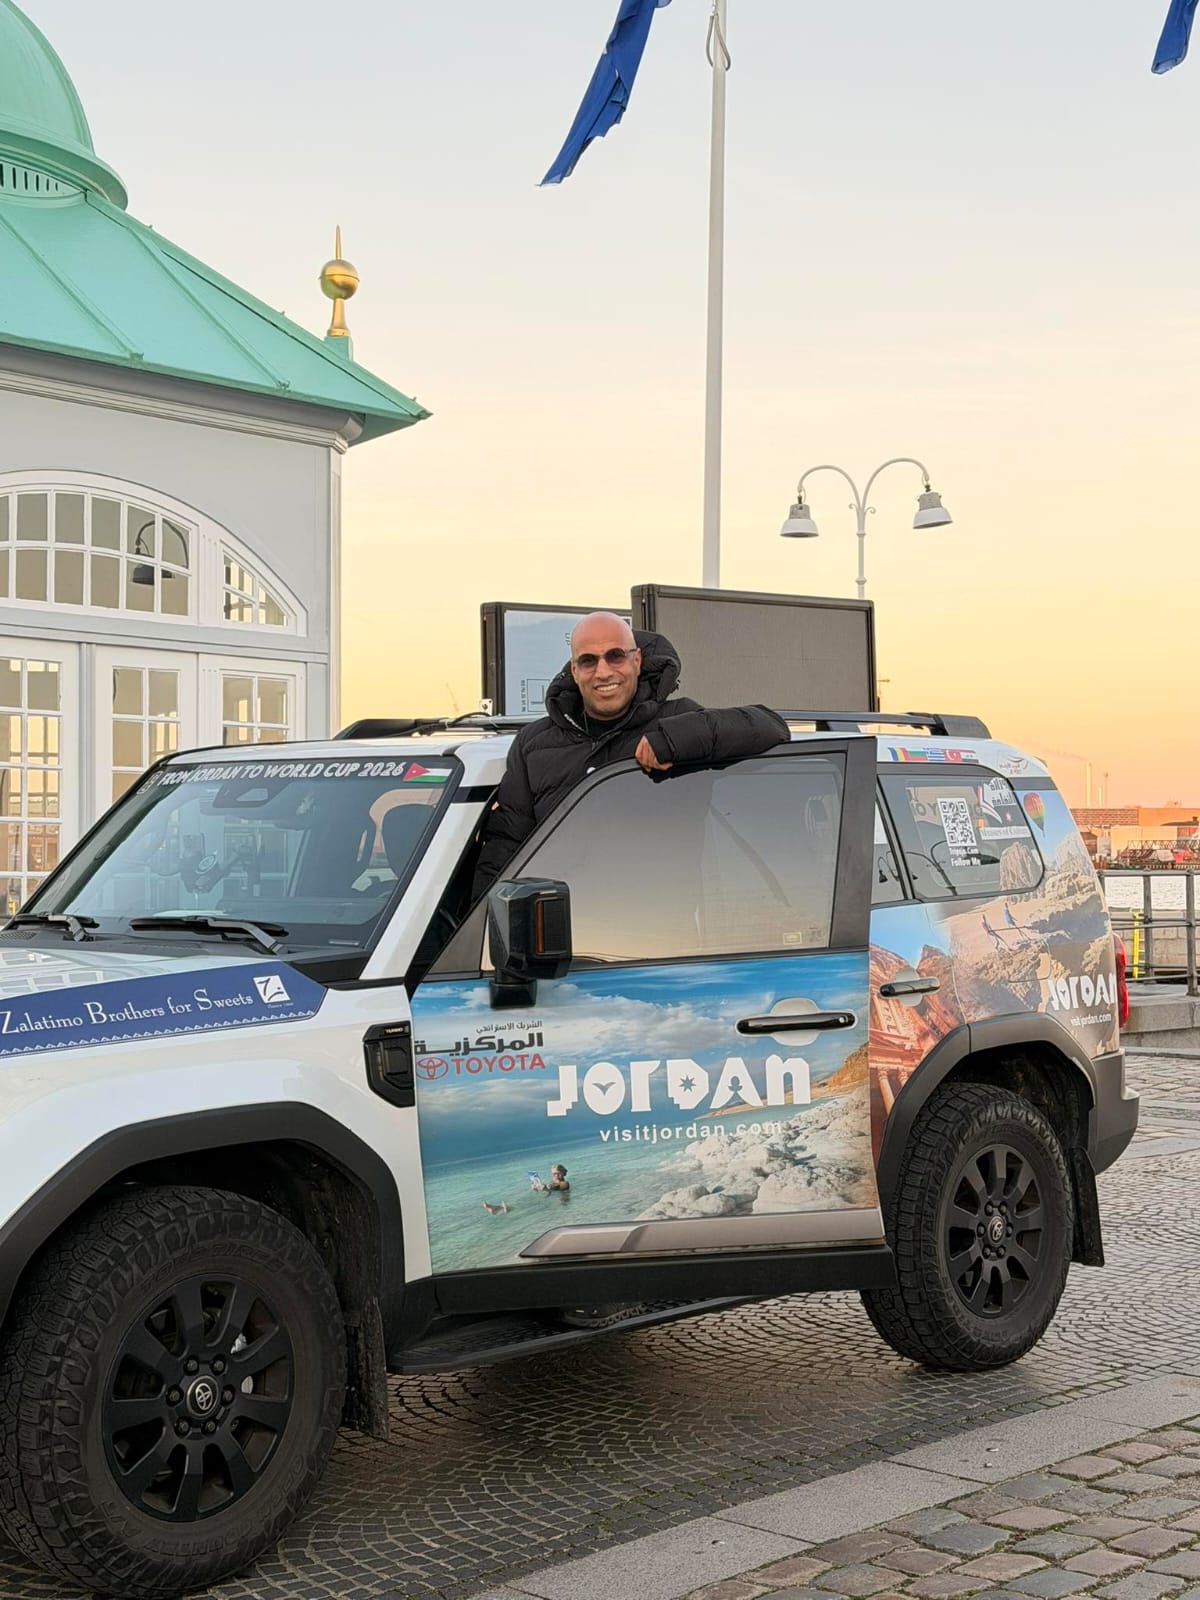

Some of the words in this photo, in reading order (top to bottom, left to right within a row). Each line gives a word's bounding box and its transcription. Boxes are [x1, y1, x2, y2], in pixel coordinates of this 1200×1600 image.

[157, 768, 193, 786] FROM
[187, 765, 244, 783] JORDAN
[241, 764, 264, 779] TO
[263, 763, 324, 778] WORLD
[323, 762, 360, 778] CUP
[357, 761, 406, 777] 2026
[0, 1010, 83, 1034] Zalatimo
[83, 1001, 166, 1025] Brothers
[168, 996, 192, 1015] for
[194, 988, 254, 1011] Sweets
[414, 1032, 544, 1056] المركزية
[451, 1053, 546, 1075] TOYOTA
[600, 1120, 783, 1144] visitjordan.com
